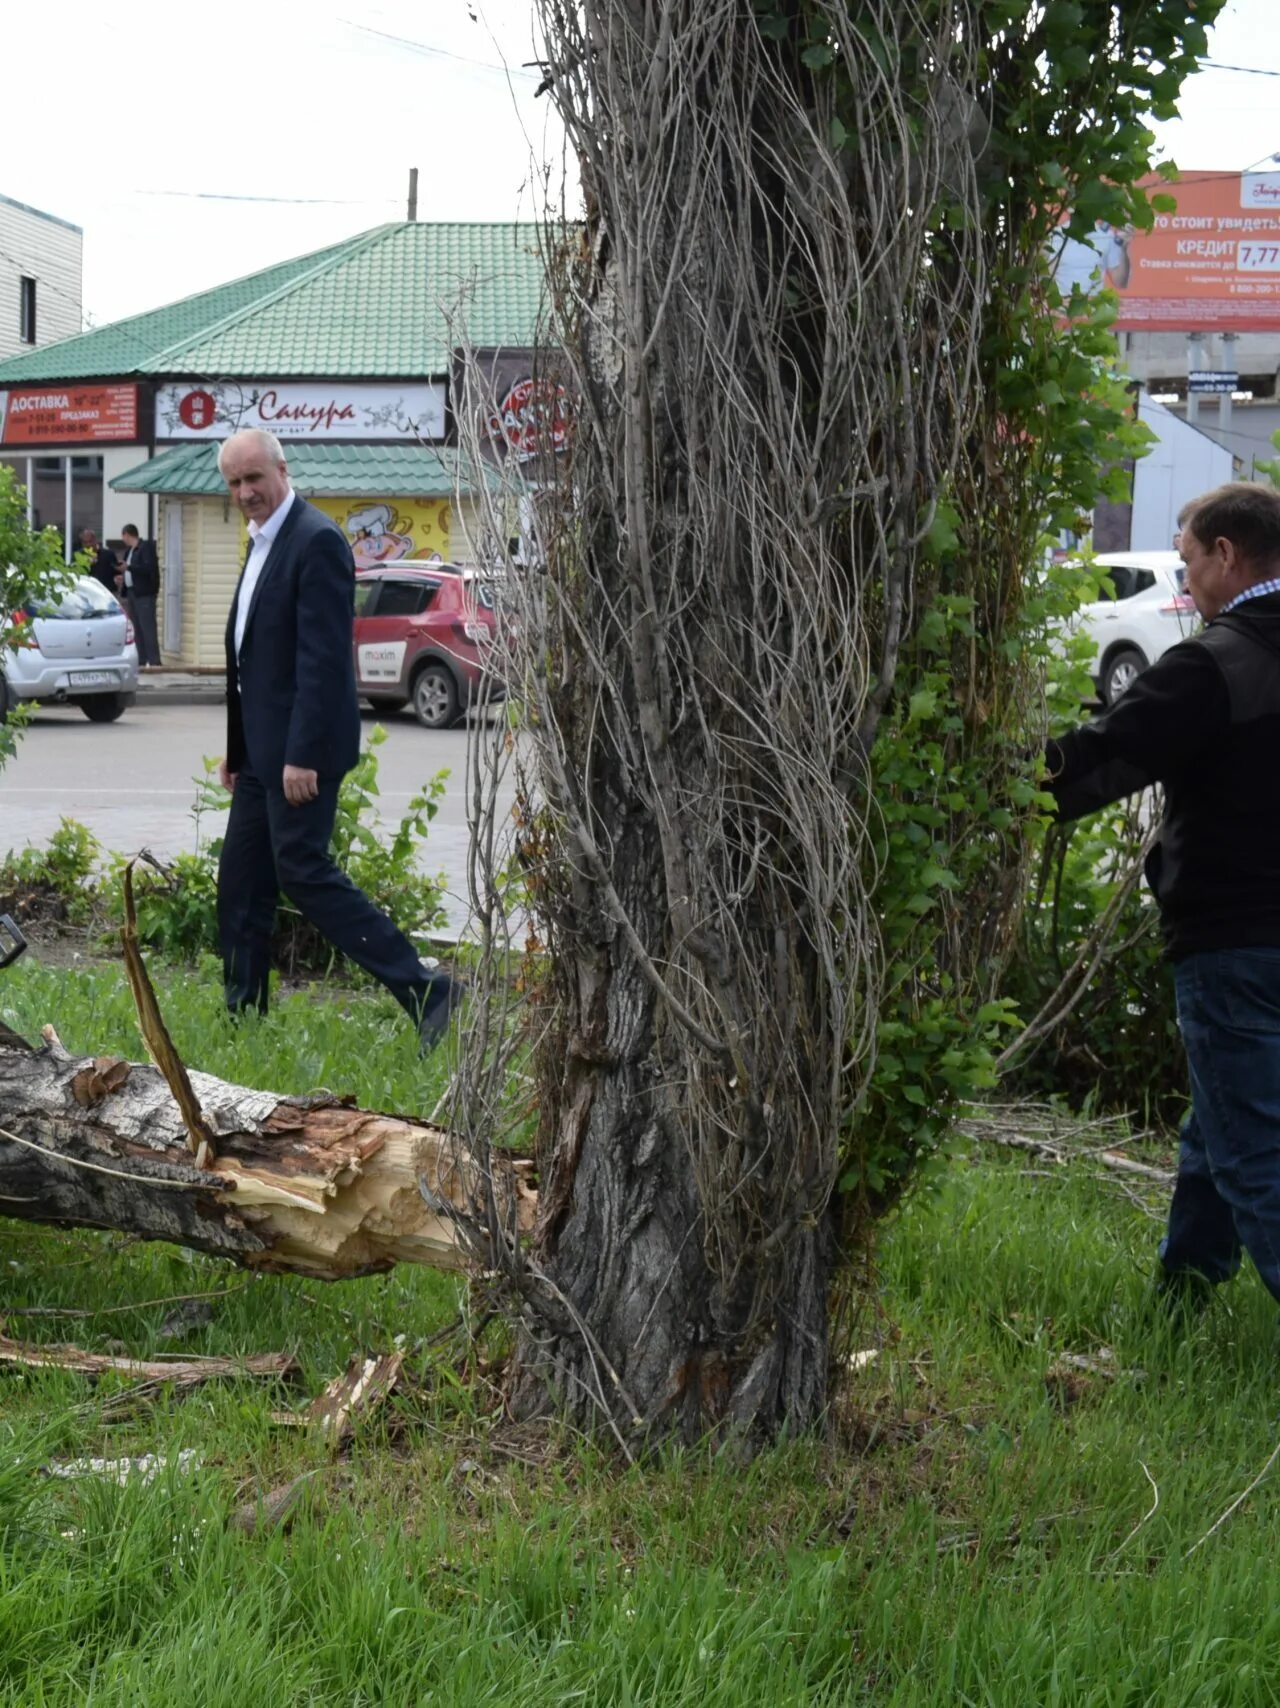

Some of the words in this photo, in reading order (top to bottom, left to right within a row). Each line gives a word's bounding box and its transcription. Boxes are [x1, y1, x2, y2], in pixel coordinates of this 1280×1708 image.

[1172, 216, 1213, 229] стоит
[1176, 239, 1235, 257] КРЕДИТ
[1140, 258, 1171, 269] Ставка
[10, 395, 69, 413] ДОСТАВКА
[258, 391, 356, 432] Сакура
[60, 410, 99, 421] ПРЕДЗАКАЗ
